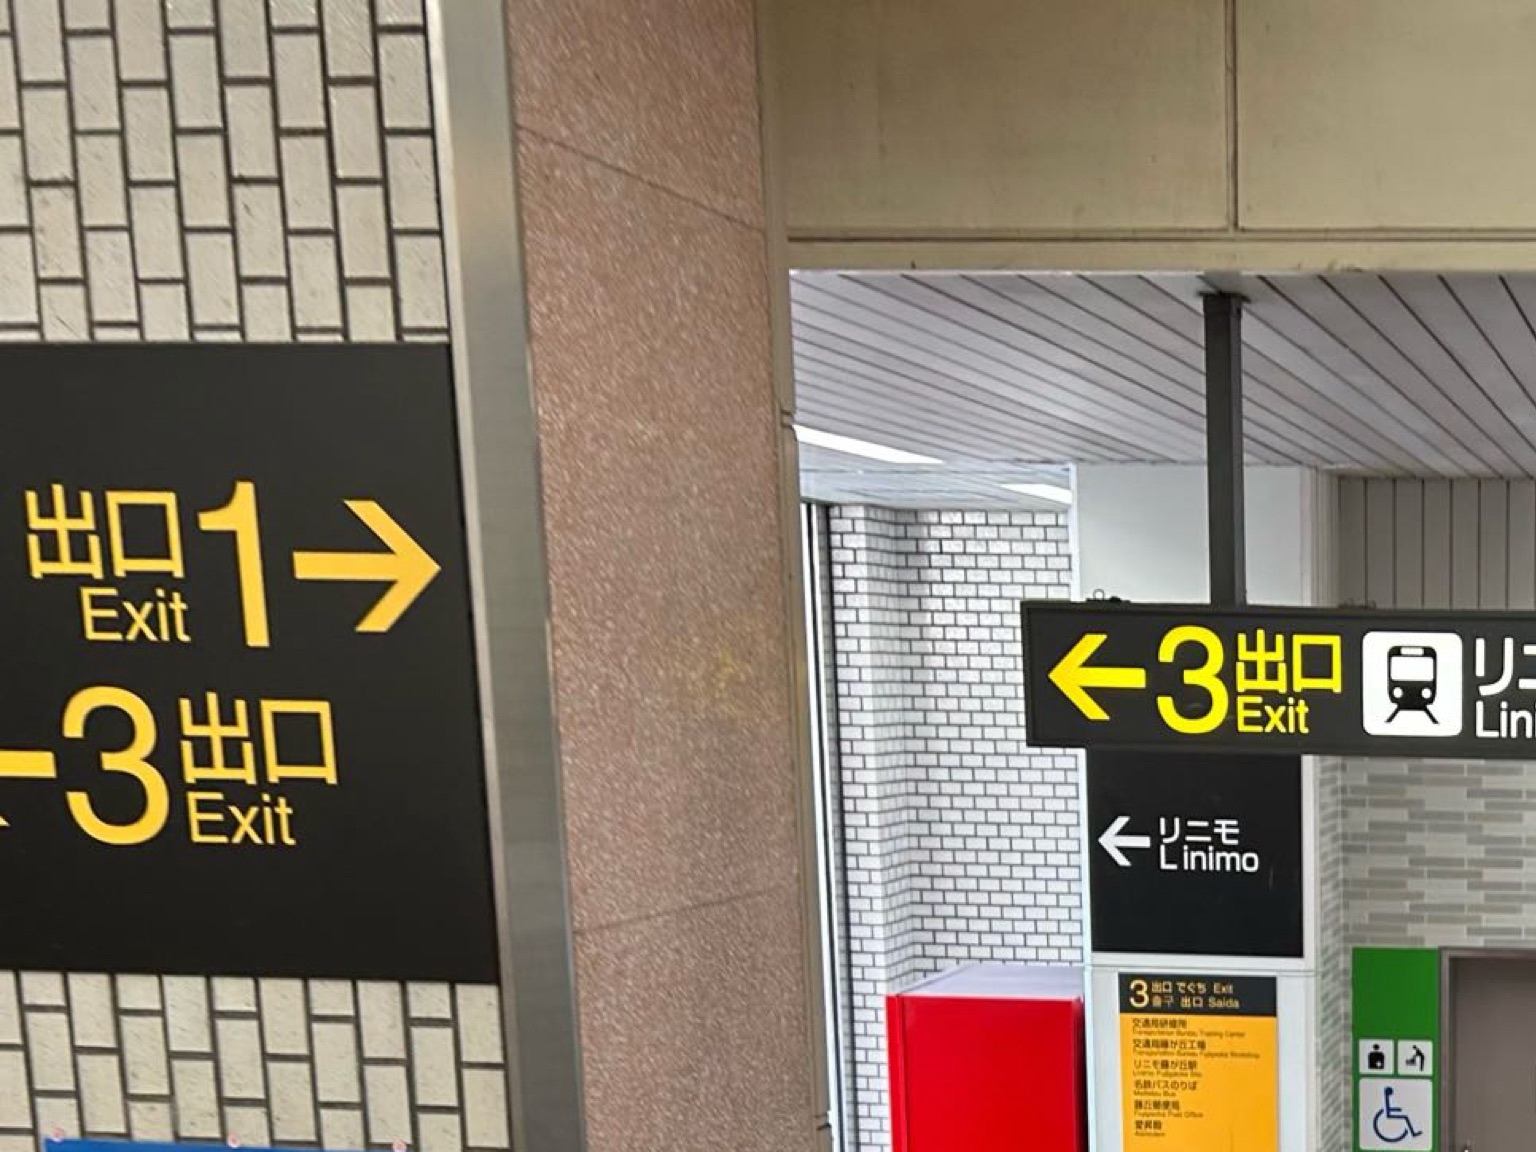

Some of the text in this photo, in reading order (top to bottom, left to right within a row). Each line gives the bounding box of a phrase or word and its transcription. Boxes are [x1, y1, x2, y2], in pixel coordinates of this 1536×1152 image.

[25, 481, 270, 647] 出口 1
[79, 587, 191, 643] Exit
[1156, 625, 1343, 734] 3 出口
[1236, 697, 1310, 734] Exit
[63, 685, 338, 846] 3 出口
[187, 791, 297, 846] Exit
[1158, 818, 1240, 846] リニモ
[1159, 845, 1260, 874] Linimo
[1129, 979, 1149, 1008] 3
[1152, 981, 1173, 993] 出口
[1213, 982, 1233, 994] Exit
